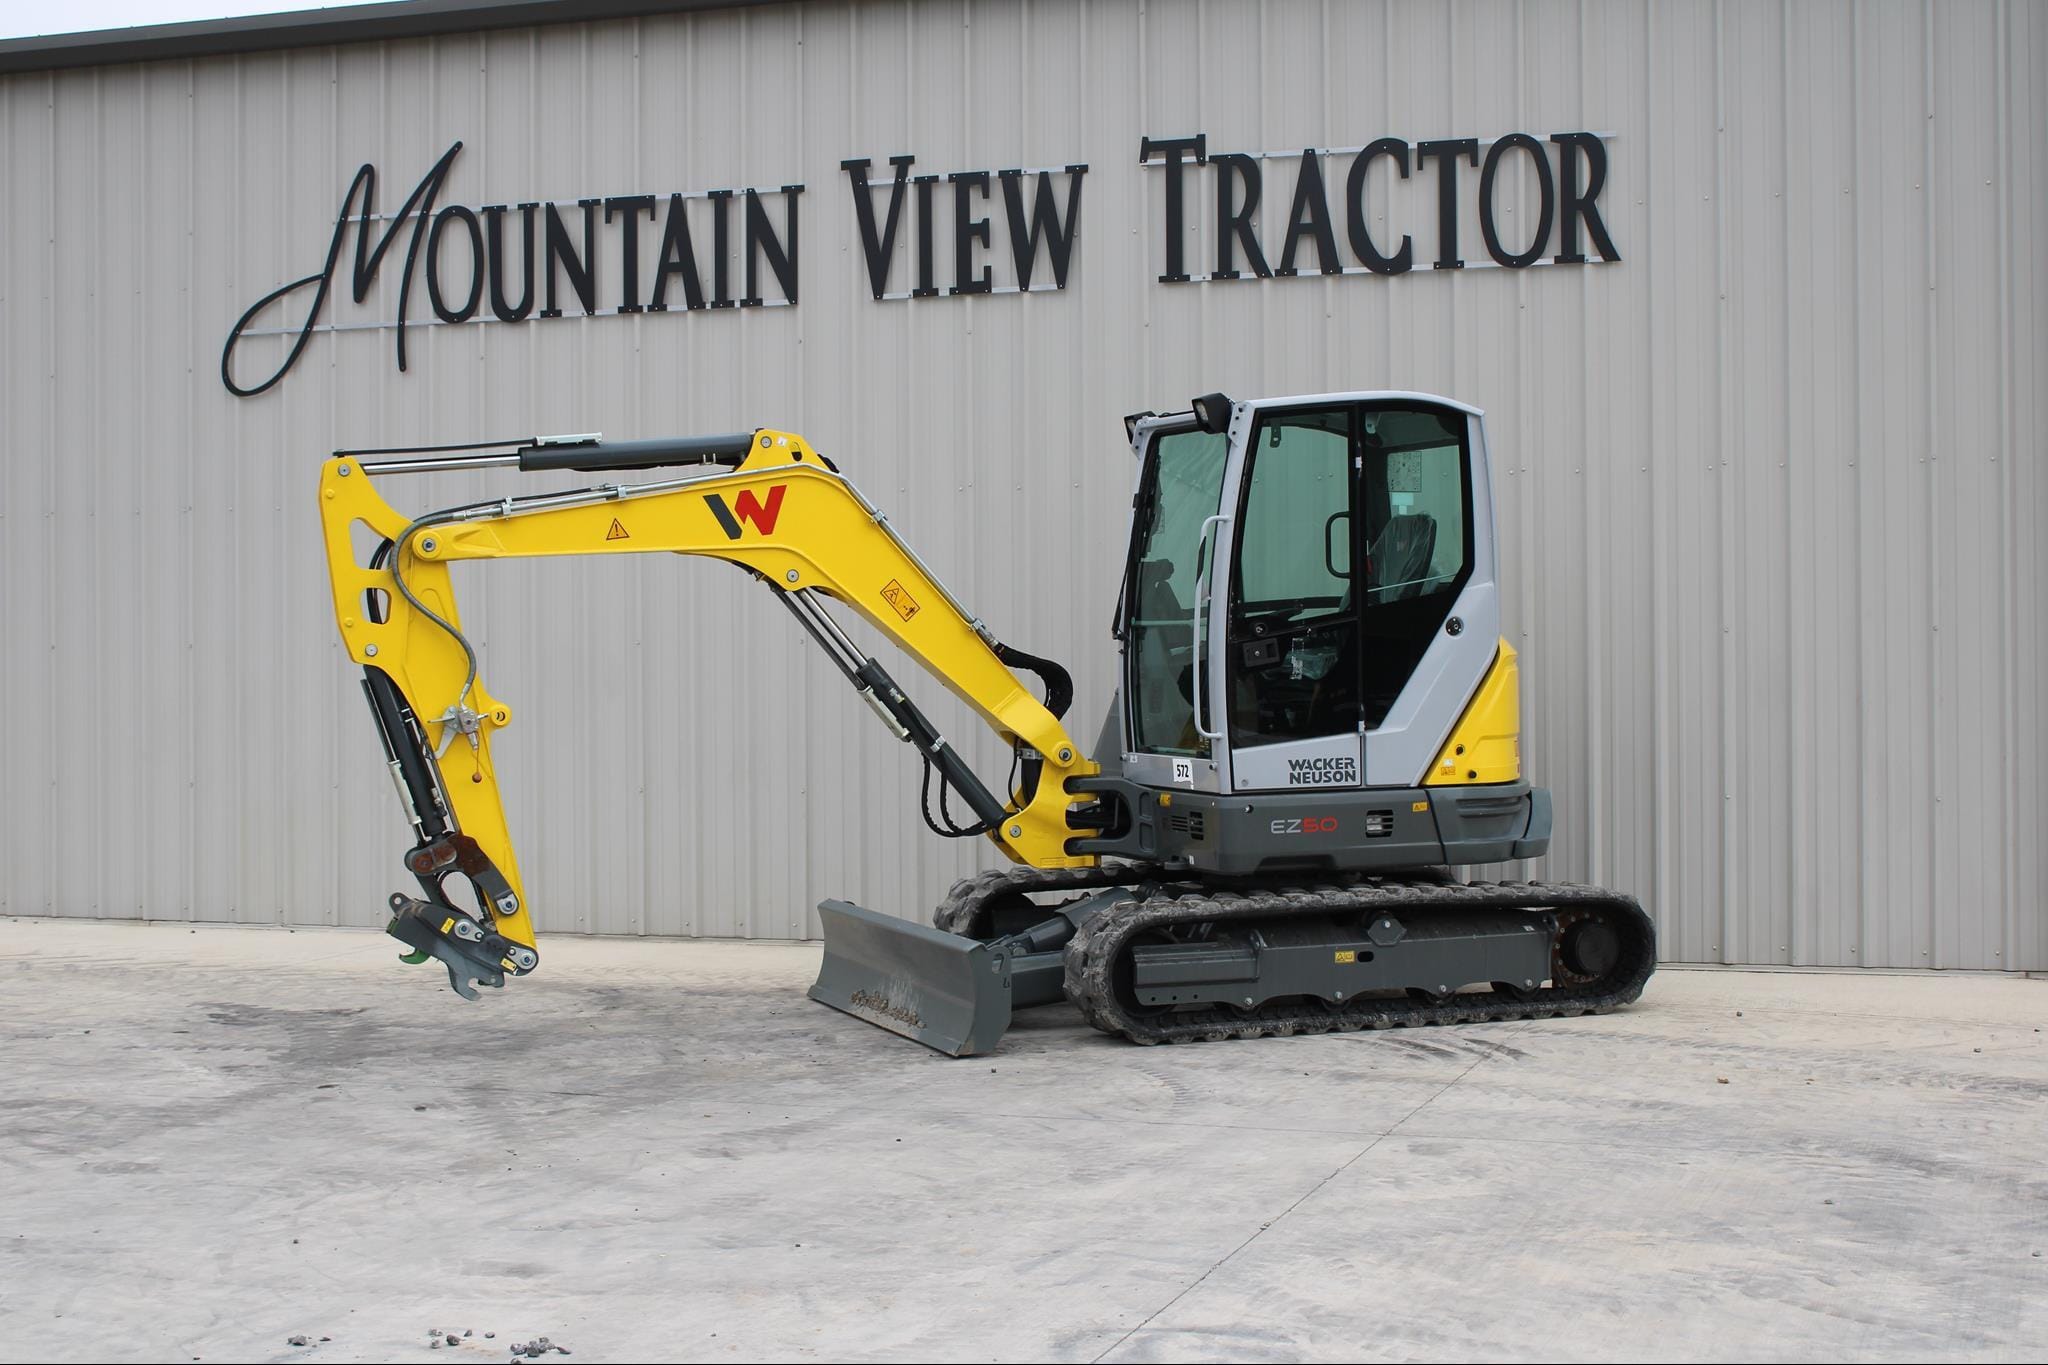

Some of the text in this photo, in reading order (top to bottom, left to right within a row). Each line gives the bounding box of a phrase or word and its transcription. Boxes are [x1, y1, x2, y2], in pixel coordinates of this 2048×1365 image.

[222, 132, 1622, 397] MOUNTAIN VIEW TRACTOR
[1176, 764, 1190, 778] 572
[1288, 757, 1356, 771] WACKER
[1289, 770, 1357, 785] NEUSON
[1270, 816, 1339, 834] EZ50
